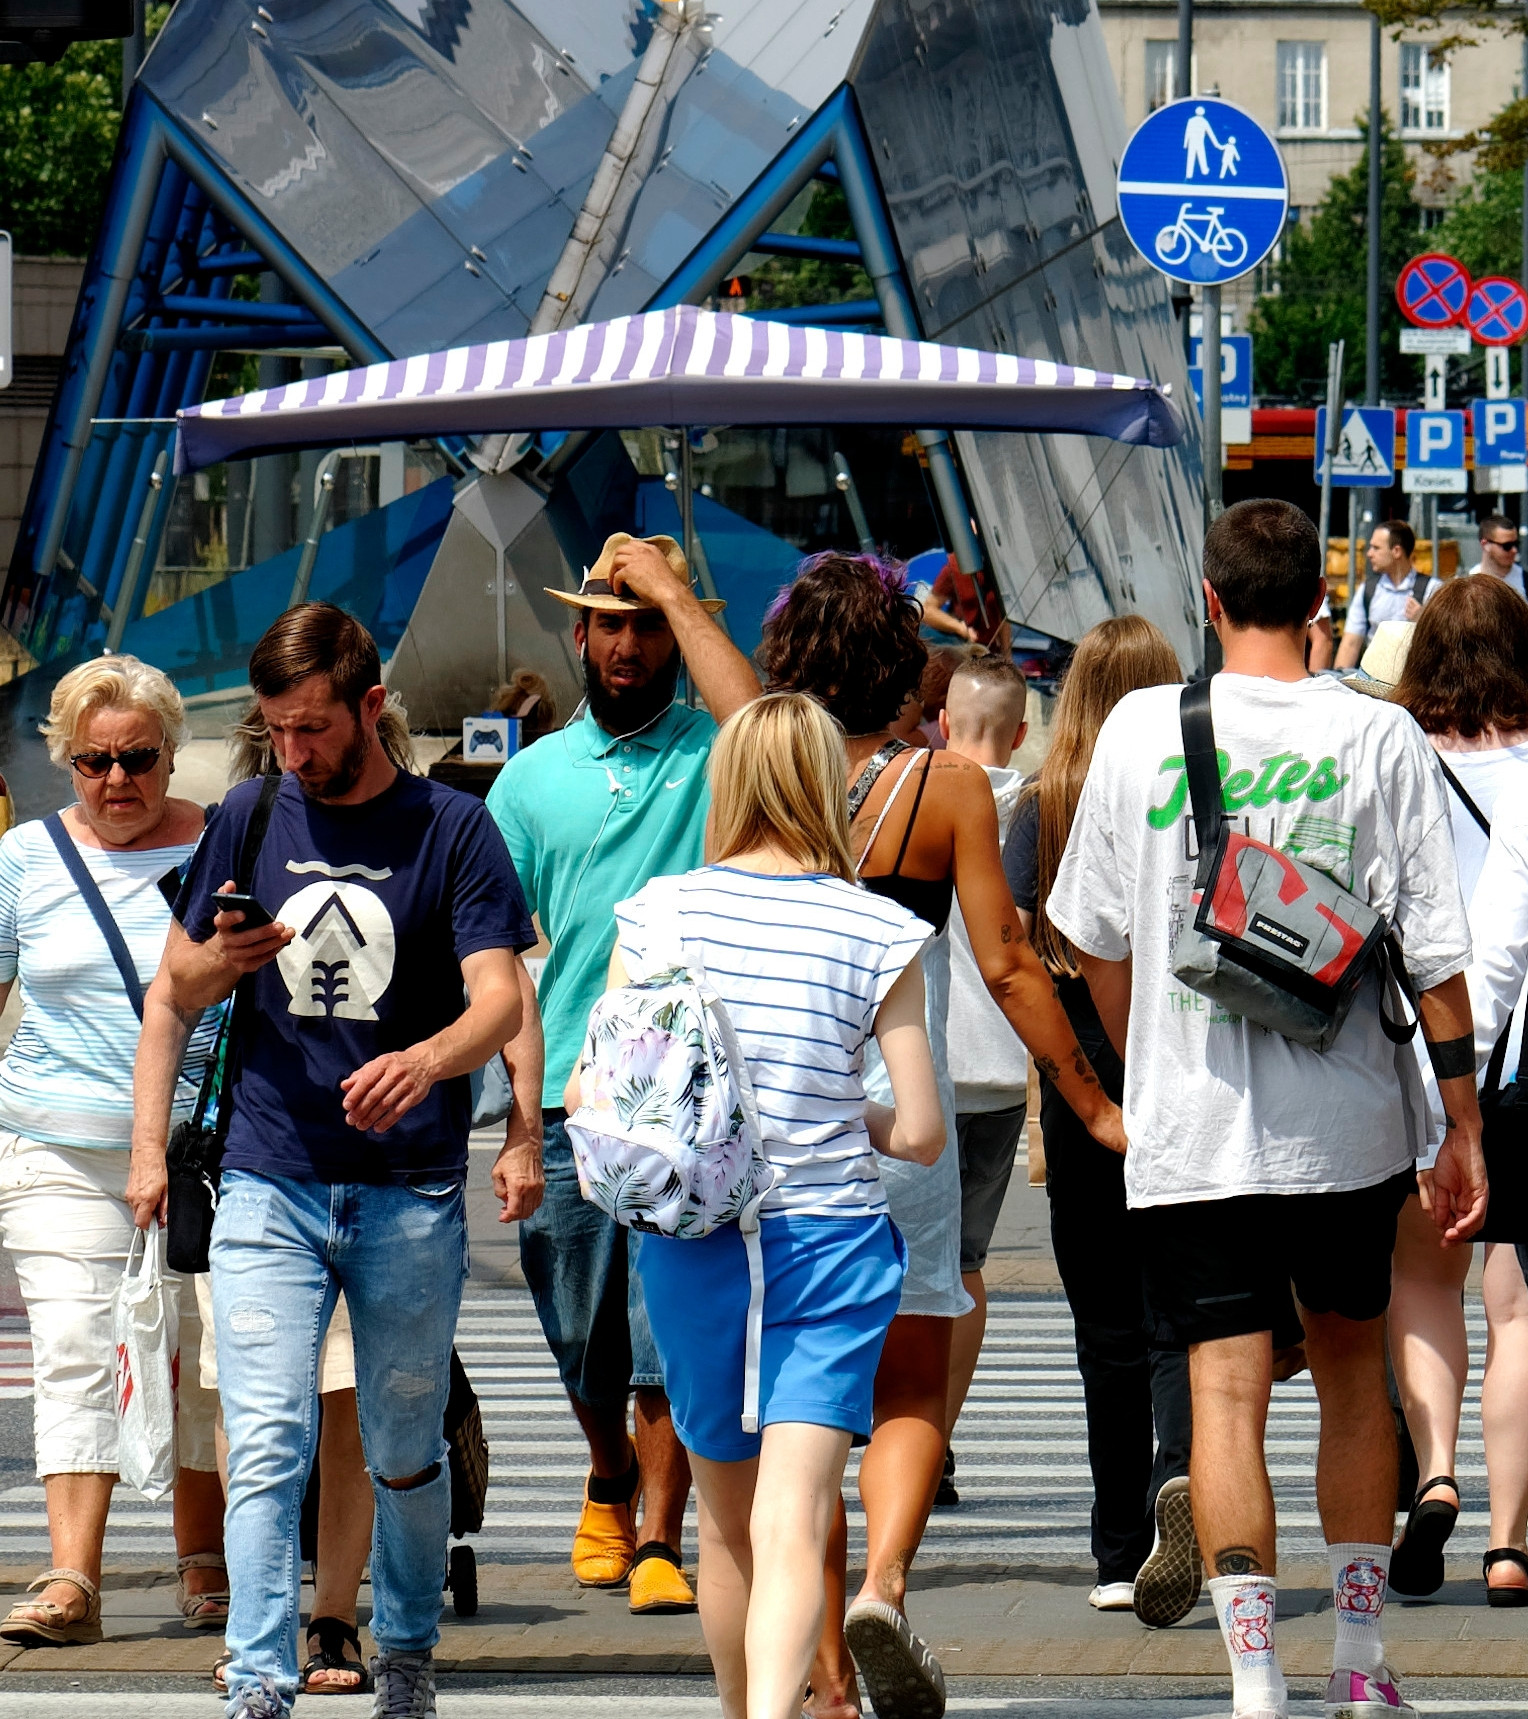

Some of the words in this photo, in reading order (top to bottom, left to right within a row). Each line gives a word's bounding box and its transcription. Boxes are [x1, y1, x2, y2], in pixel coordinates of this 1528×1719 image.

[1419, 417, 1452, 462] P
[1485, 403, 1516, 445] P
[1255, 920, 1304, 948] FREITAG
[1167, 991, 1204, 1013] THE
